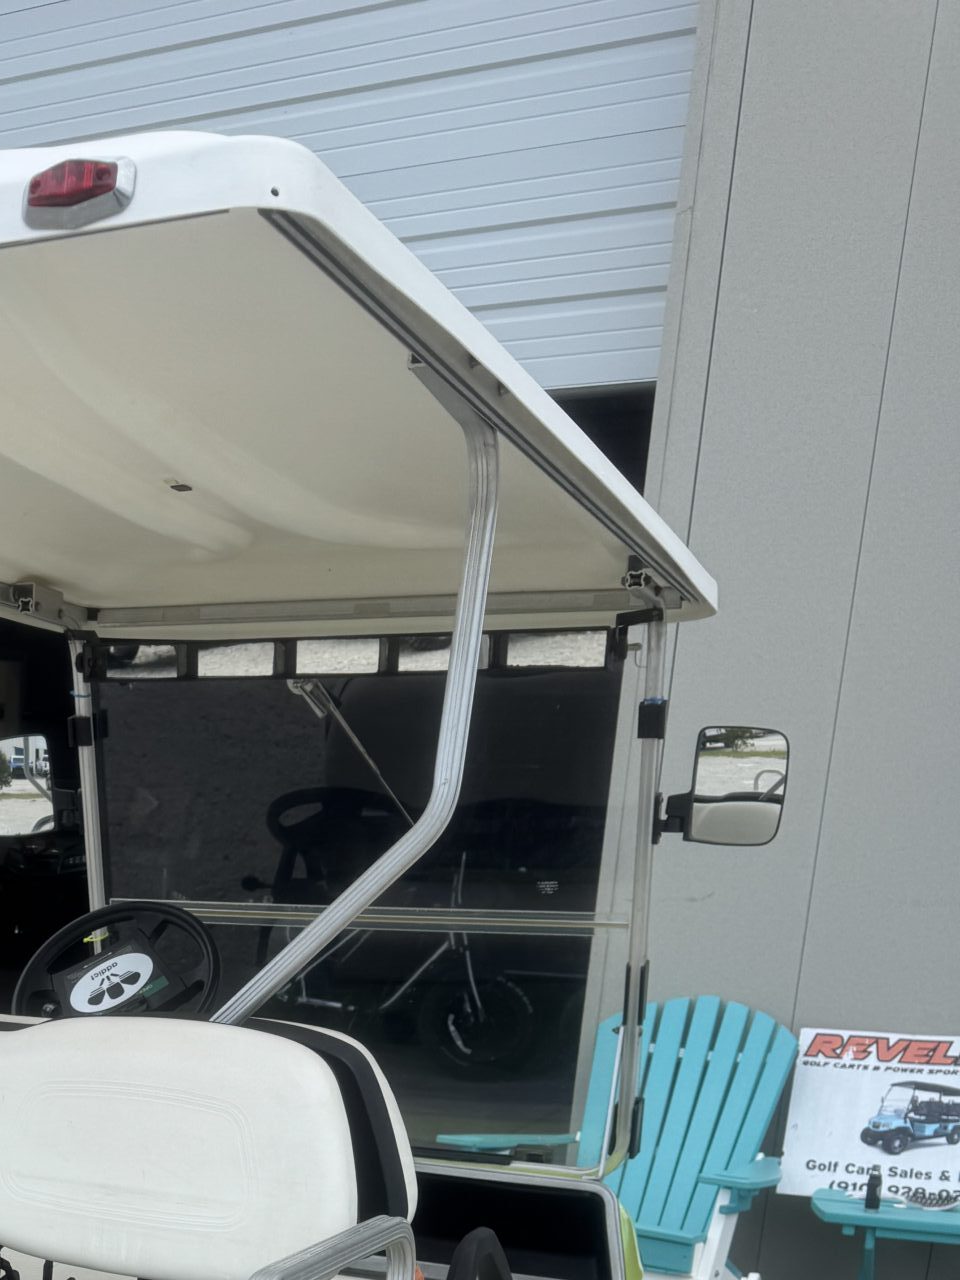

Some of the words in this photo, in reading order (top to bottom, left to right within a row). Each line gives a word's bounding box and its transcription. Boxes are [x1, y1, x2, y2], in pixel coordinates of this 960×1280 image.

[803, 1033, 959, 1066] REVEL
[802, 1060, 830, 1068] GOLF
[833, 1062, 870, 1071] CARTS
[884, 1066, 924, 1075] POWER
[805, 1159, 838, 1173] Golf
[844, 1162, 873, 1176] Car
[888, 1165, 933, 1181] Sales
[939, 1169, 951, 1182] &
